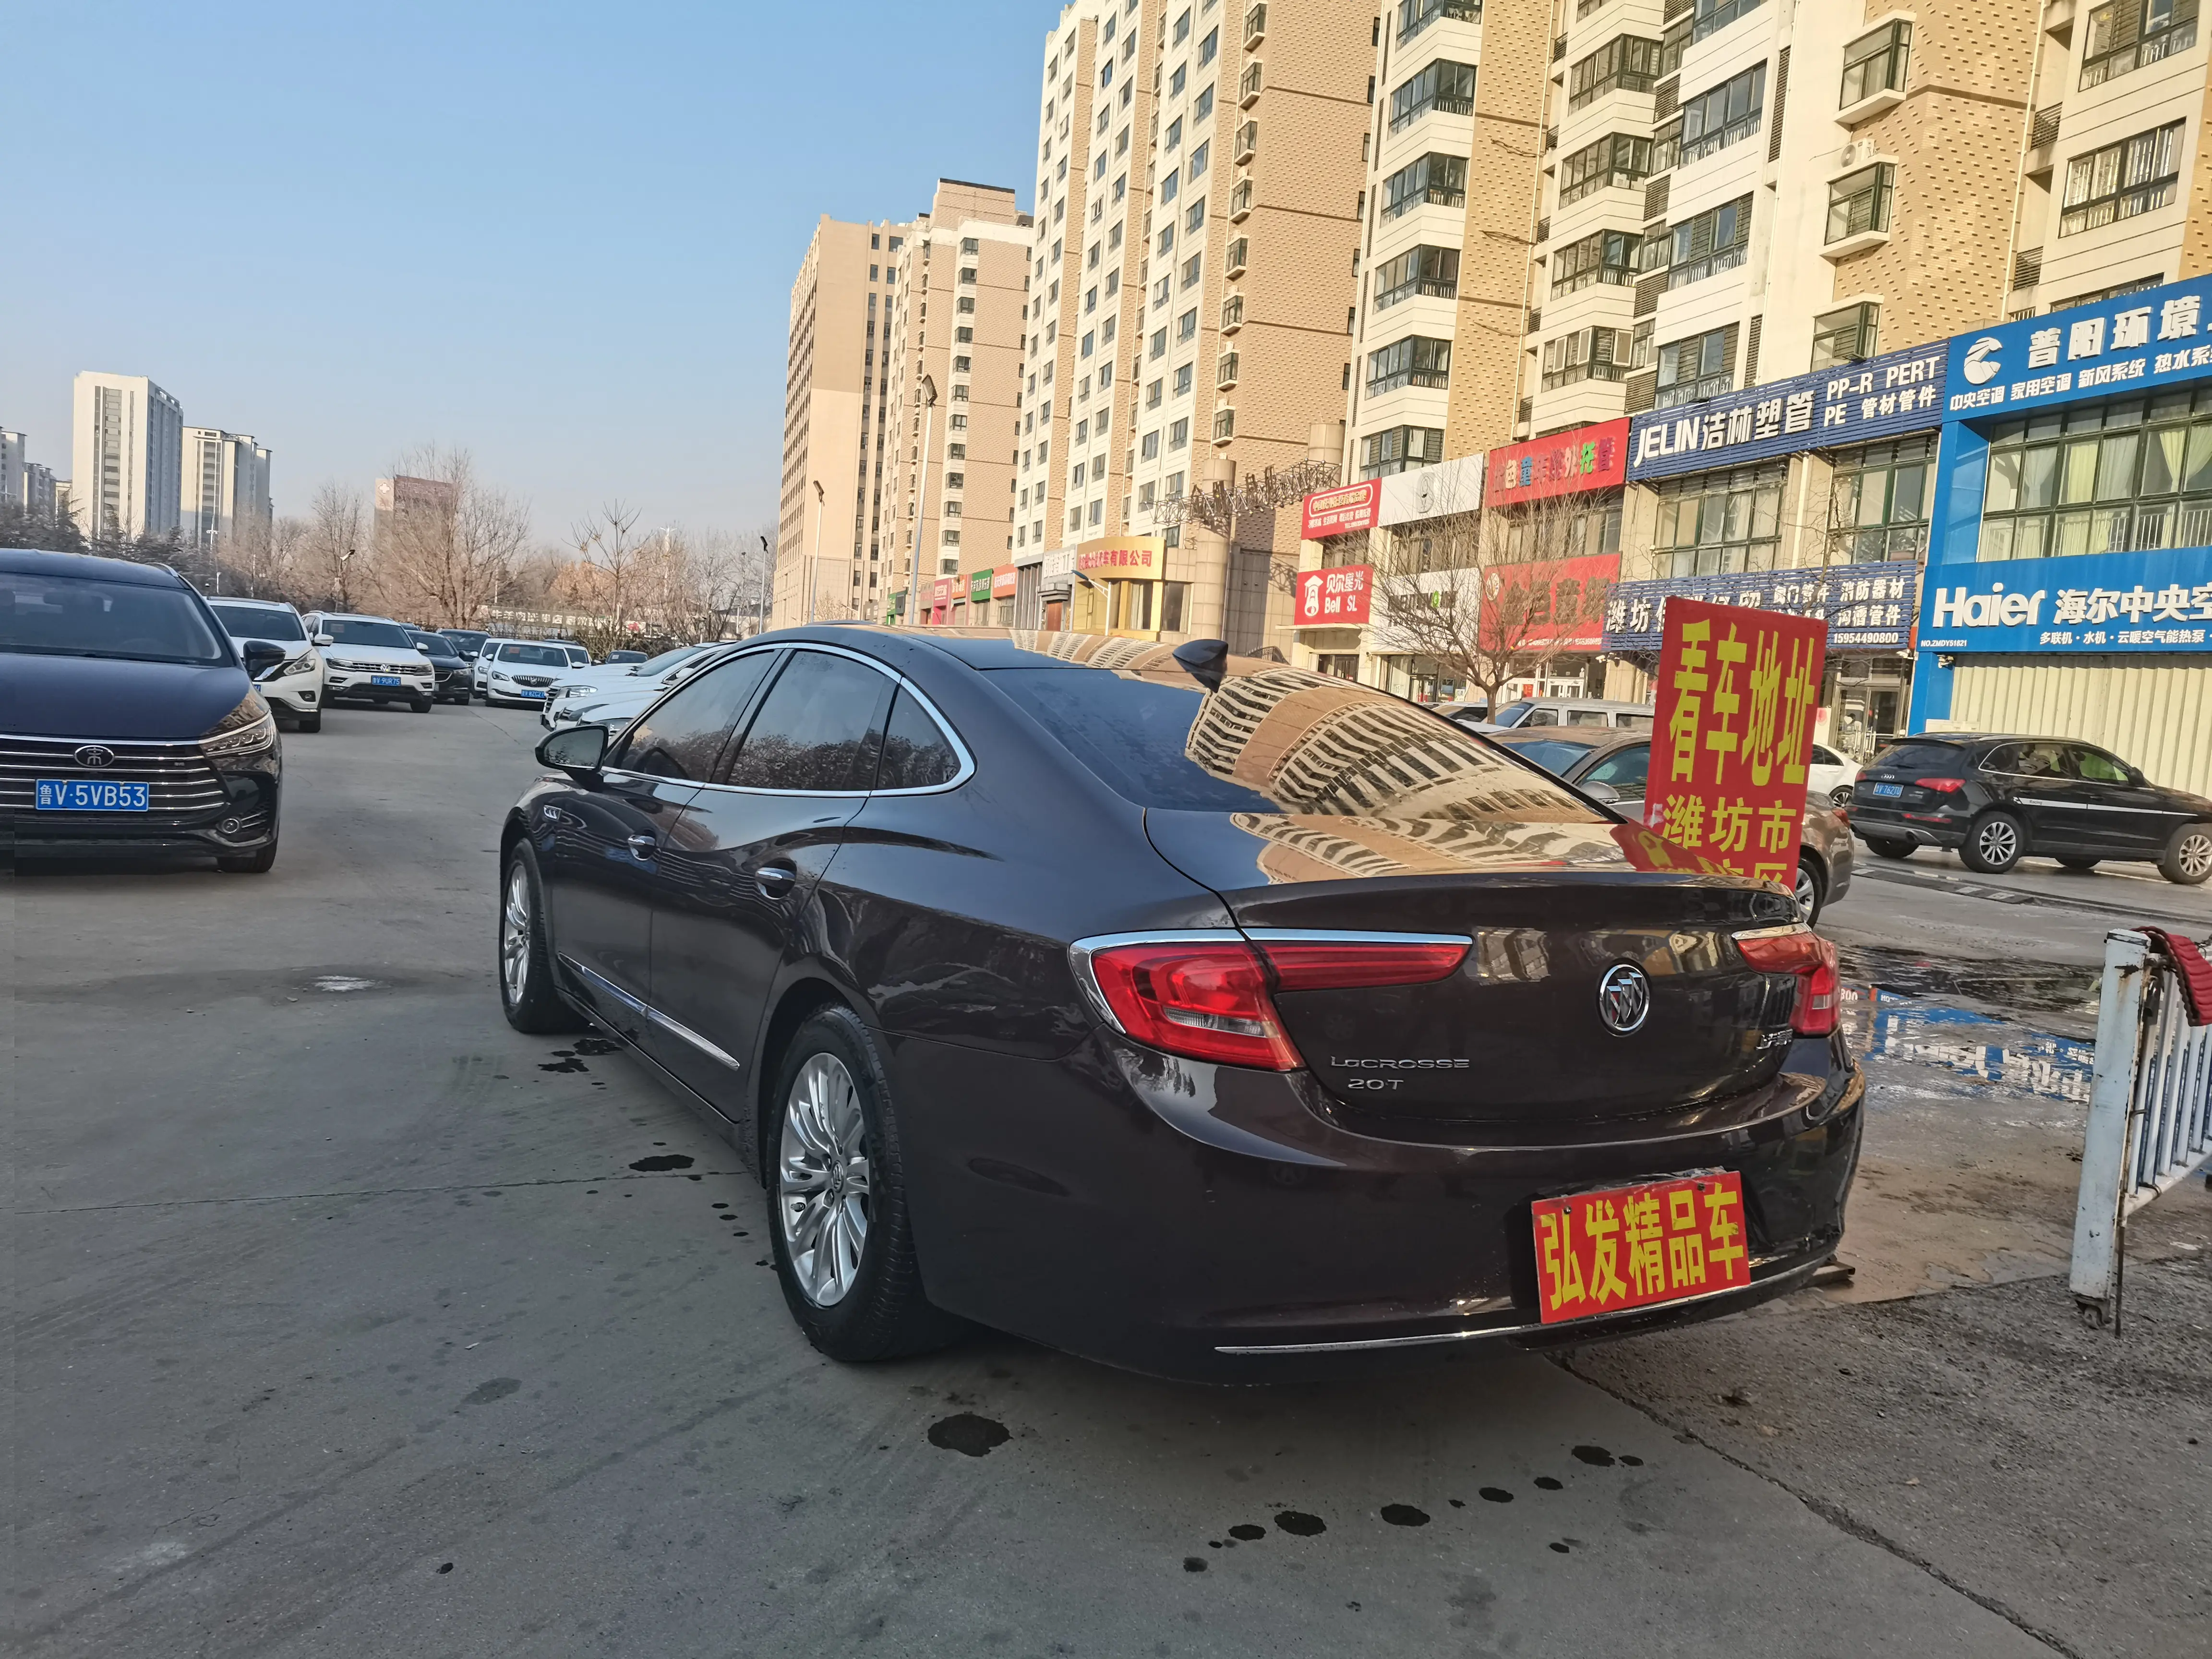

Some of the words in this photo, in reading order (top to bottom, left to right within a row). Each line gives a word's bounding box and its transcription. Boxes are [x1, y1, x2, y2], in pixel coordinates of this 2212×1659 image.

[2028, 296, 2212, 369] 普阳环境
[1826, 372, 1873, 401] PP-R
[1886, 356, 1941, 390] PERT
[1950, 386, 2005, 411] 中央空调
[2011, 372, 2071, 400] 家用空调
[2078, 358, 2146, 388] 新风系统
[2154, 344, 2212, 374] 热水系
[1824, 402, 1847, 427] PE
[1862, 385, 1936, 420] 管材管件
[1633, 416, 1701, 469] JELIN
[1702, 390, 1816, 451] 洁林塑管
[1324, 596, 1341, 614] Bell
[1346, 595, 1358, 612] SL
[1326, 570, 1364, 595] 贝尔星光
[1839, 577, 1905, 602] 消防器材
[1933, 582, 2045, 628] Haier
[2053, 583, 2212, 625] 海尔中央空
[1833, 632, 1899, 644] 15954490800
[1921, 639, 1967, 648] NO.ZMDY51821
[1669, 619, 1815, 787] 看车地址
[39, 784, 145, 806] 鲁V·5VB53
[1662, 793, 1797, 854] 潍坊市
[1541, 1182, 1744, 1311] 弘发精品车
